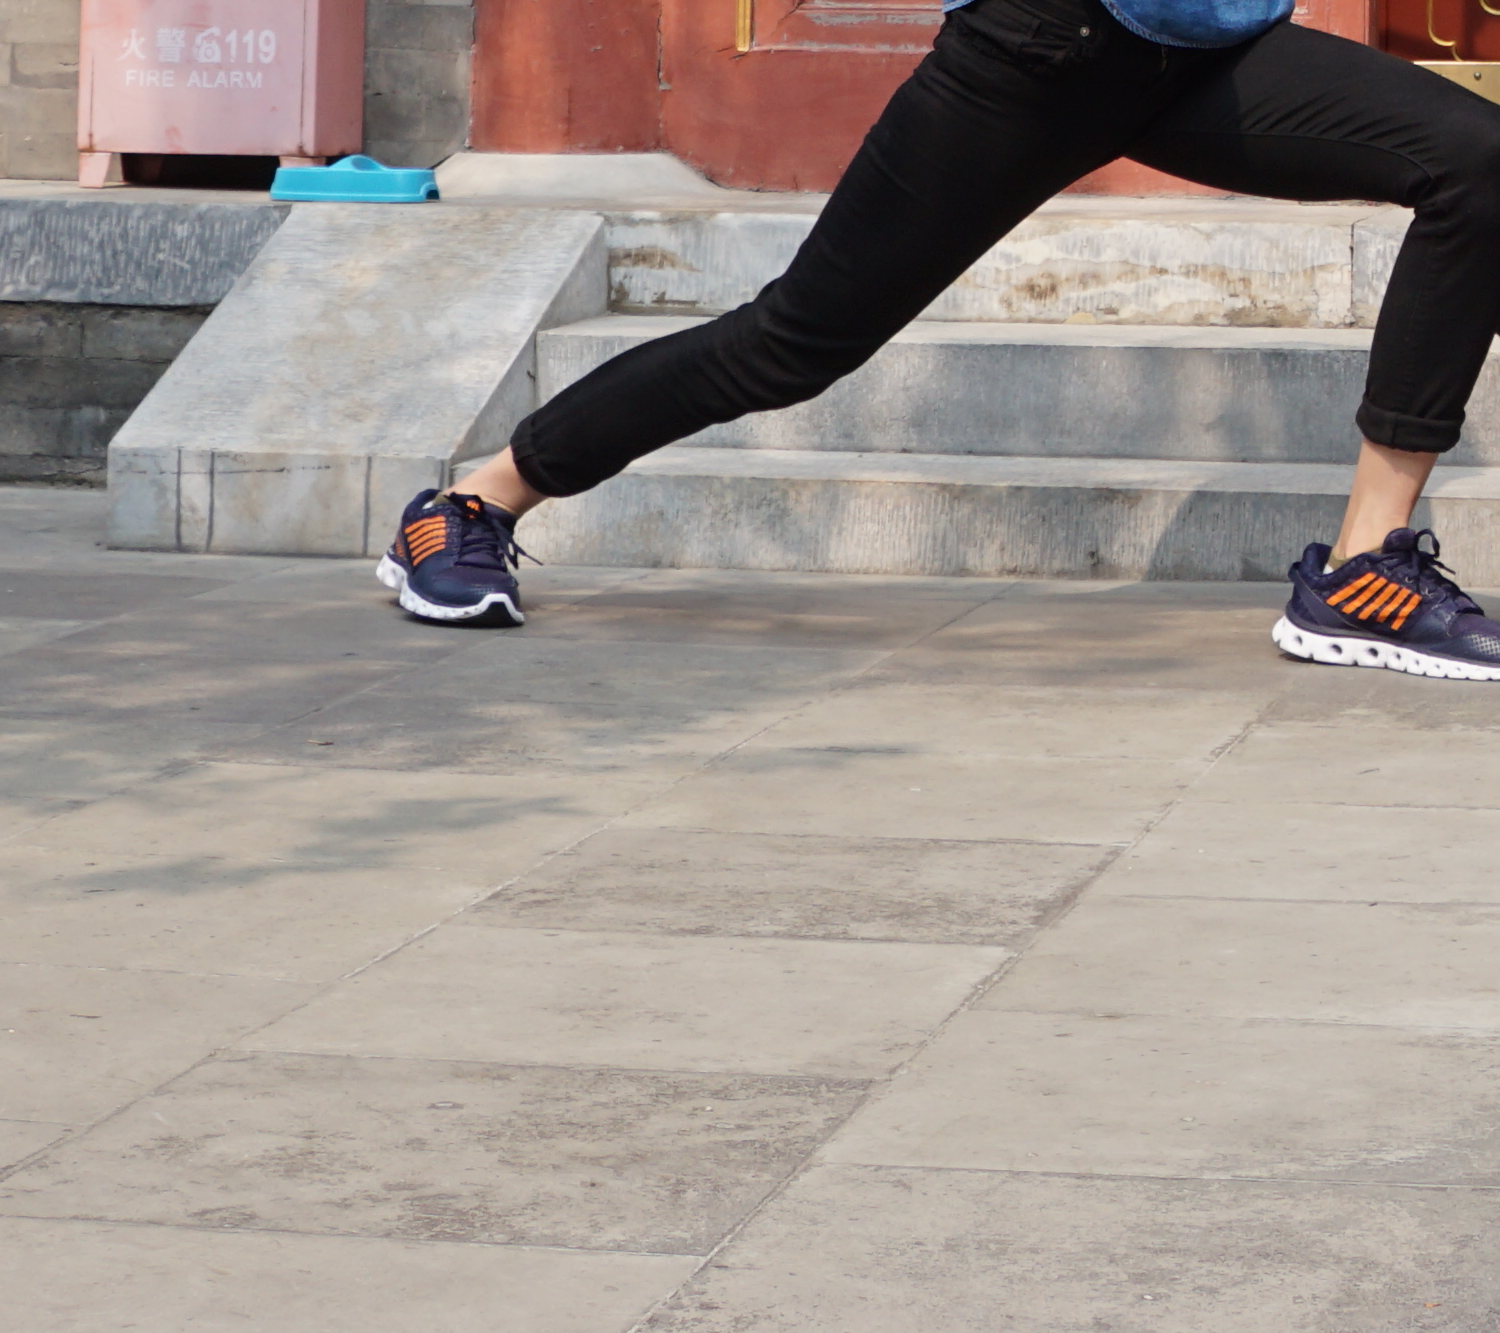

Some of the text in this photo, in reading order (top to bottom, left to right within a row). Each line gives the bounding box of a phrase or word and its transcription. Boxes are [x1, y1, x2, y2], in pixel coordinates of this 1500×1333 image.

[223, 28, 277, 64] 119
[125, 70, 263, 89] FIRE ALARM
